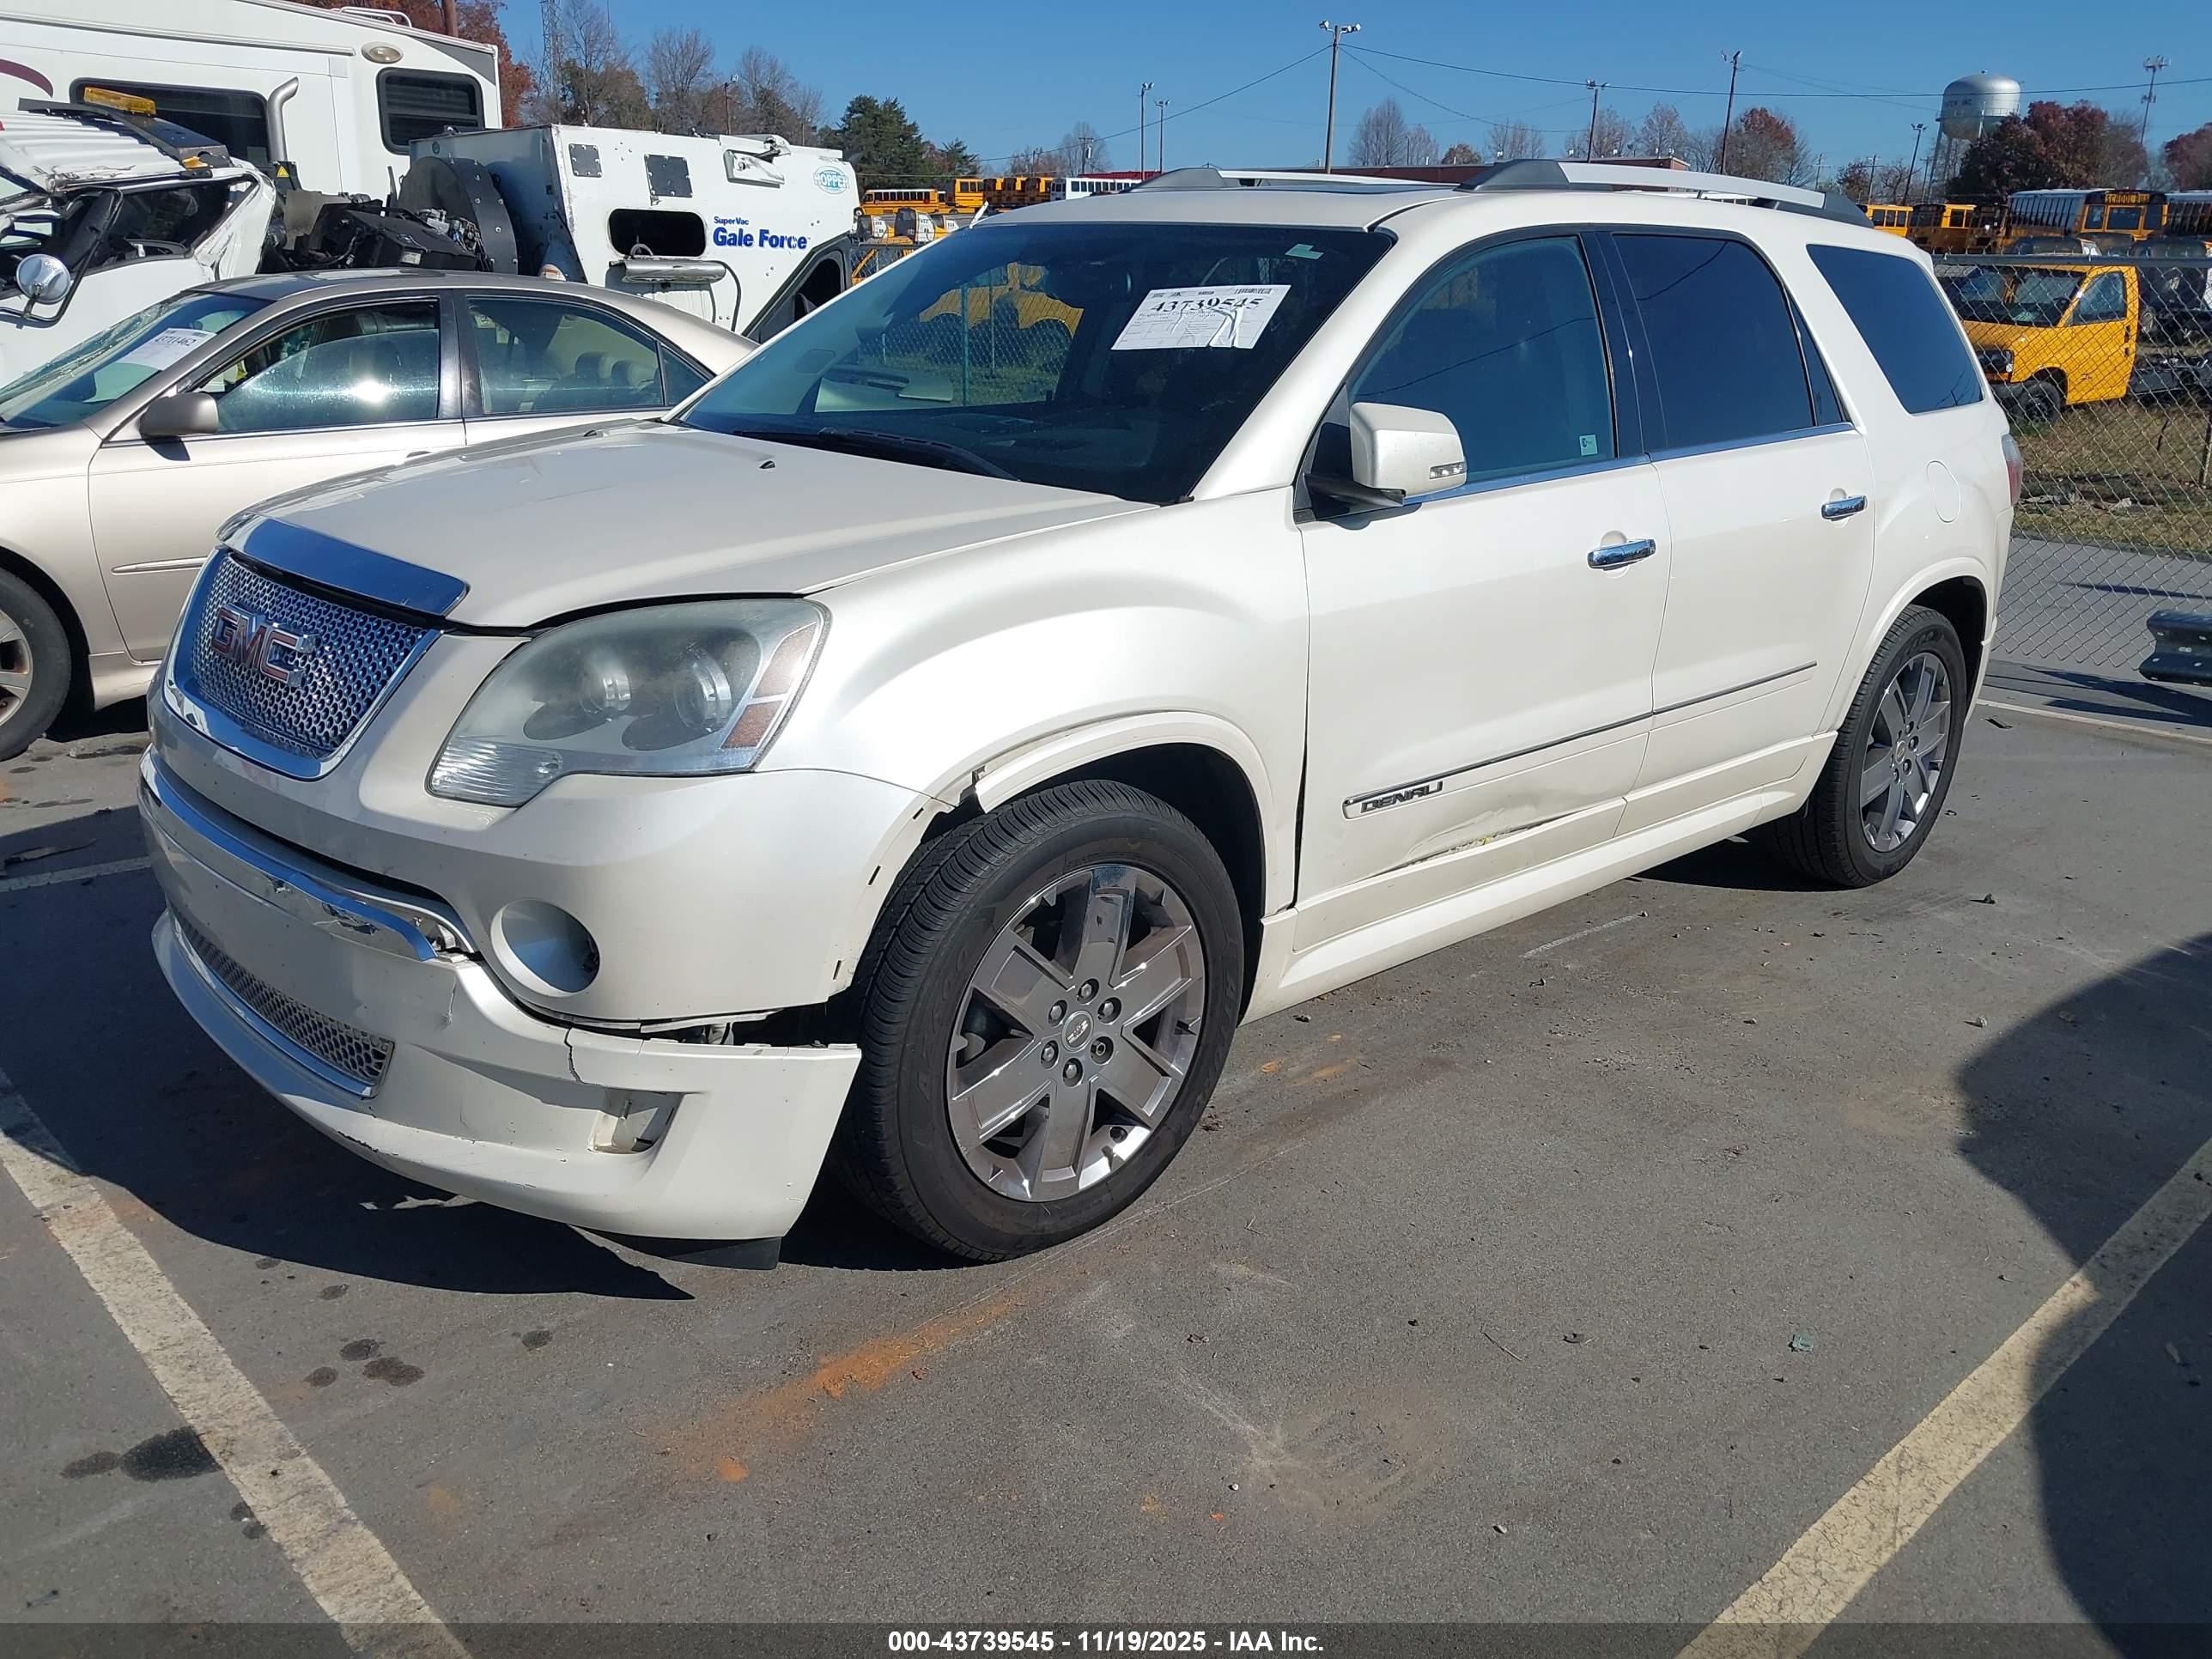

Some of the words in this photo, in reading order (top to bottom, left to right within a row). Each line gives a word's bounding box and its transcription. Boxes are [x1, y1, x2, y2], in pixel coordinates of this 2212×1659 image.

[714, 216, 750, 226] SuperVac
[713, 227, 754, 247] Gale
[758, 228, 808, 249] Force
[210, 603, 308, 685] GMC
[1360, 780, 1443, 813] DENALI
